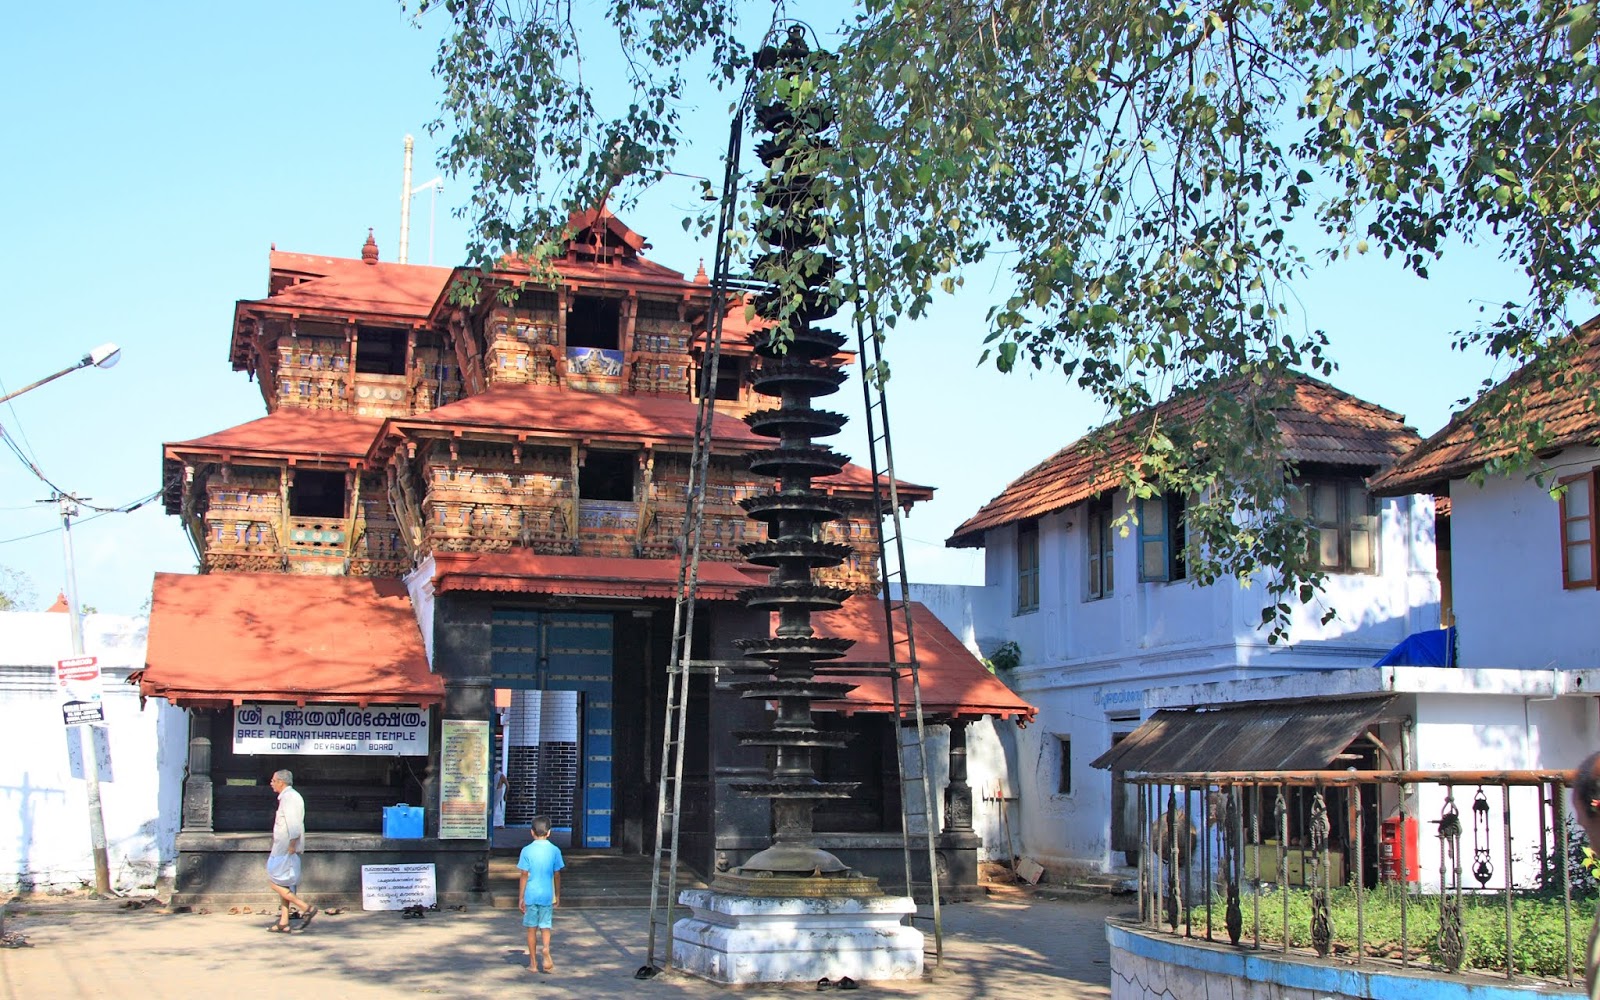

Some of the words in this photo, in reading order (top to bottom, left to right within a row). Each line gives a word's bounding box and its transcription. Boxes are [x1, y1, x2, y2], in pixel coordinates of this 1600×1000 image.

[237, 729, 265, 739] SREE
[269, 730, 371, 741] POORNATHRAYEESA
[375, 731, 416, 741] TEMPLE
[271, 742, 300, 750] COCHIN
[313, 743, 357, 751] DEVASWOM
[368, 743, 393, 751] BOARD
